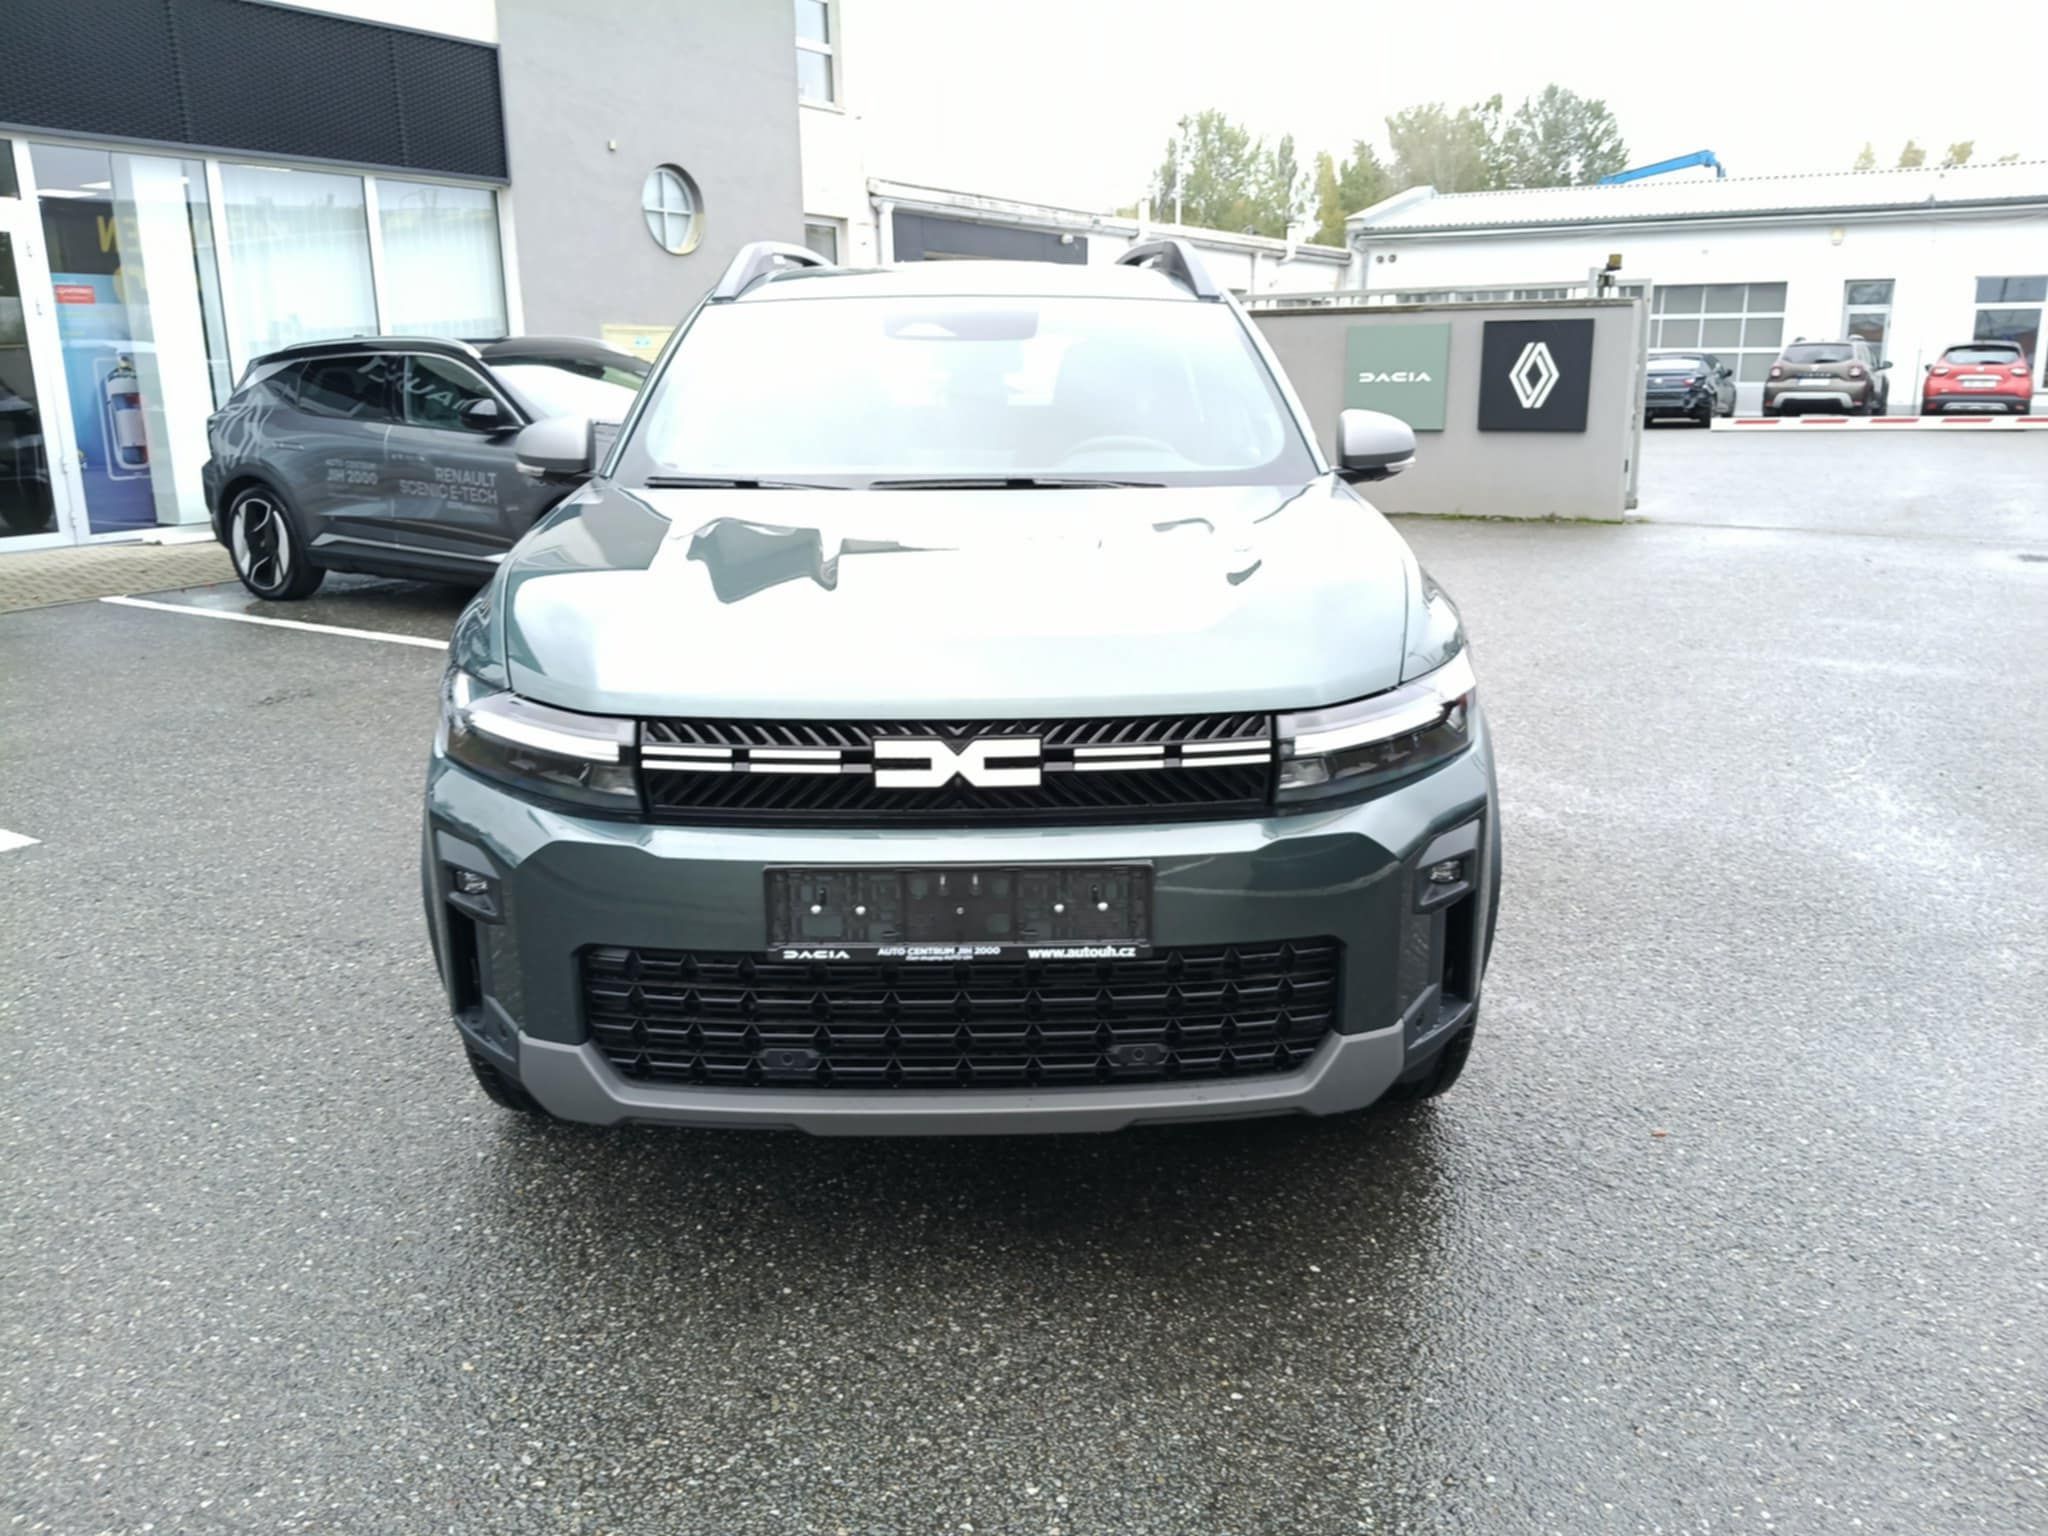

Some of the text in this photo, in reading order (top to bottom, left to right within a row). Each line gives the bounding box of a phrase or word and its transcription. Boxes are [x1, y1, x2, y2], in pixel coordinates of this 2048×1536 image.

[1359, 371, 1431, 383] DACIA
[346, 470, 378, 486] 2000
[434, 467, 497, 487] RENAULT
[449, 484, 498, 505] E-TECH
[783, 949, 851, 960] DACIA
[877, 945, 905, 956] AUTO
[974, 945, 1001, 955] 2000
[1027, 945, 1136, 959] www.autouh.cz
